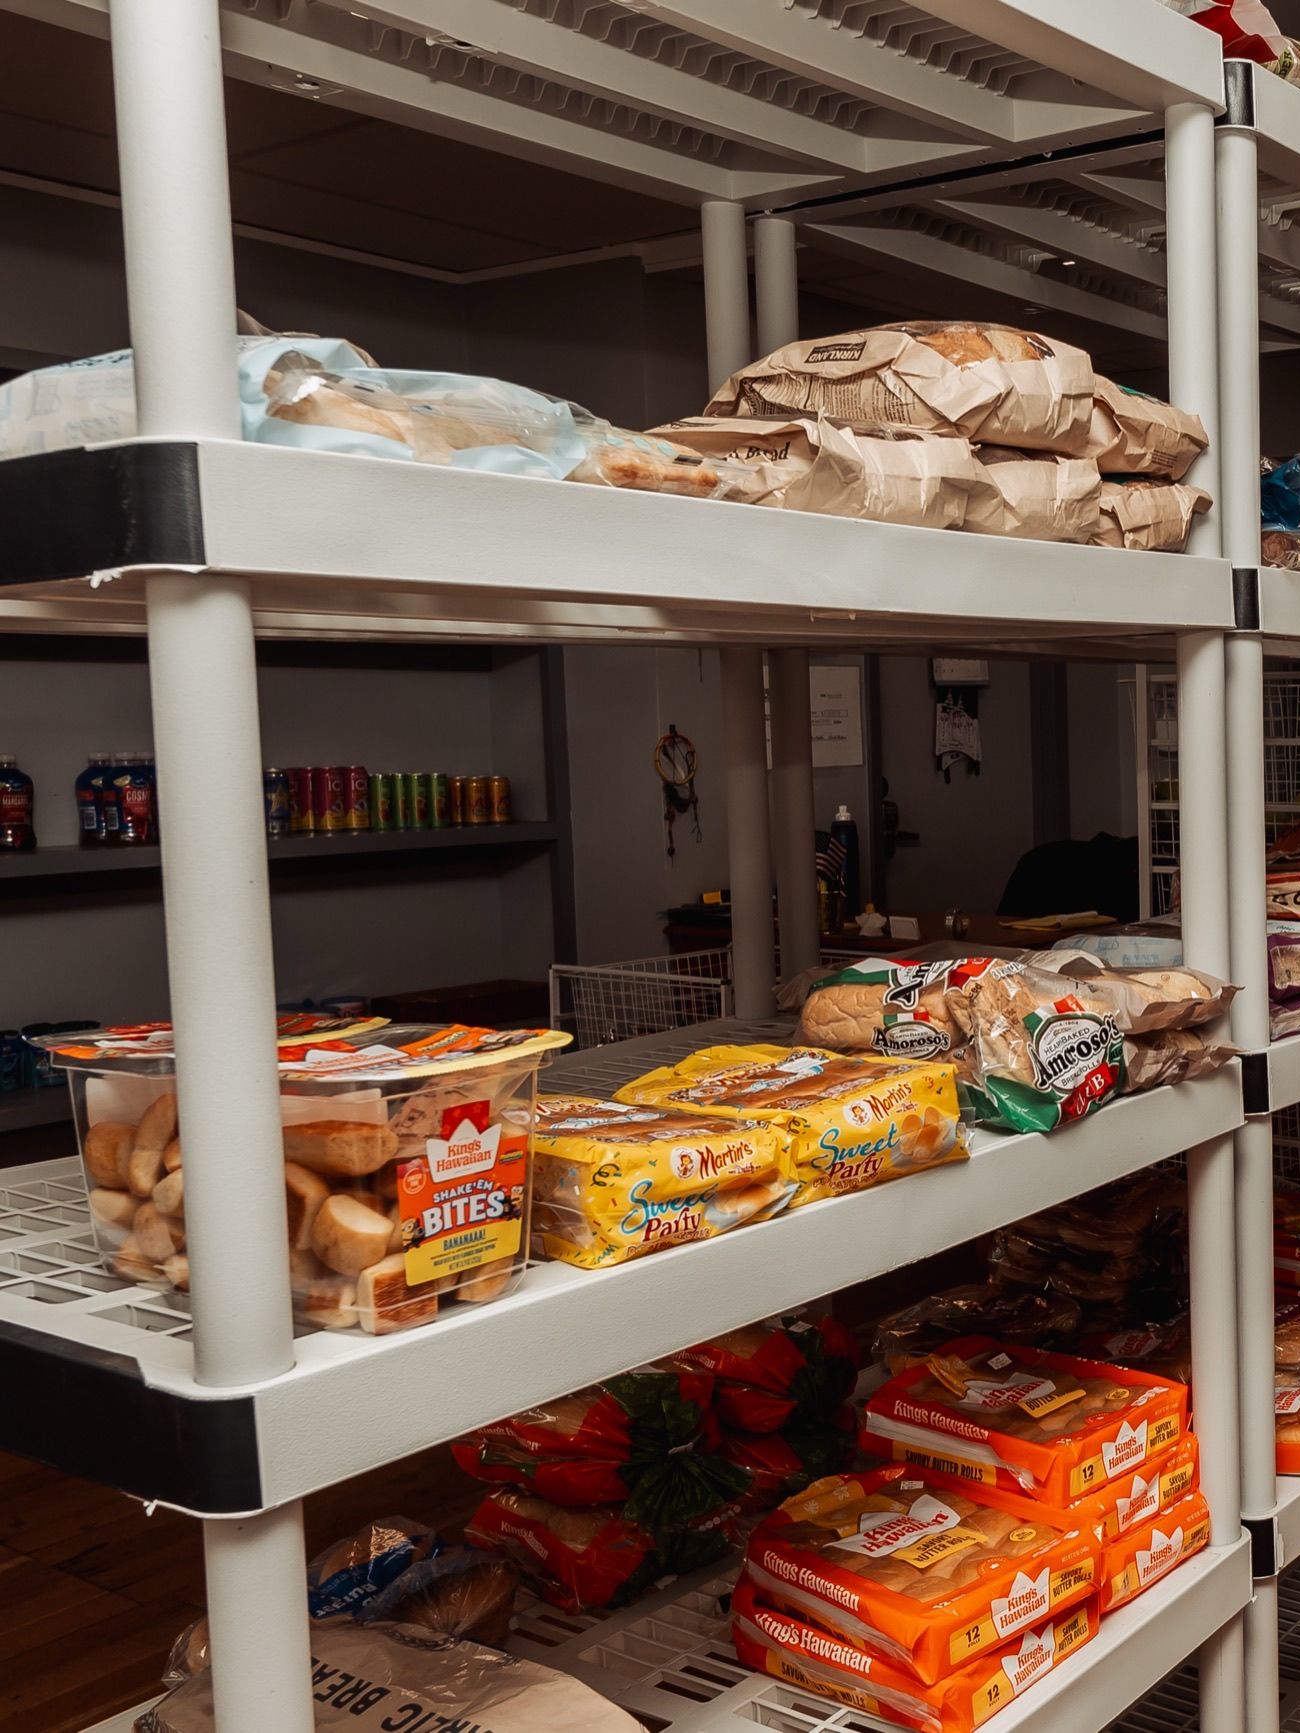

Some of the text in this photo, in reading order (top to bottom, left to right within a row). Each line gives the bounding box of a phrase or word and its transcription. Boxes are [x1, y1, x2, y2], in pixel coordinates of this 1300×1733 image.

[808, 349, 862, 363] KIRKLAND
[872, 1028, 951, 1051] Amoroso's
[869, 1082, 914, 1121] Martin's
[447, 1139, 483, 1158] King's
[811, 1121, 900, 1171] Sweet
[436, 1151, 493, 1173] Hawaiian
[698, 1142, 754, 1181] Martin's
[829, 1153, 884, 1181] Party
[422, 1190, 506, 1238] BITES
[620, 1179, 719, 1236] Sweet
[642, 1207, 703, 1243] Party
[893, 1399, 990, 1441] King's Hawaiian
[1155, 1420, 1172, 1434] SAVORY
[1114, 1435, 1138, 1455] King's
[1150, 1427, 1179, 1448] BUTTER ROLLS
[905, 1450, 984, 1481] SAVORY BUTTER ROLLS
[1108, 1444, 1145, 1471] Hawaiian
[1083, 1464, 1094, 1479] 12
[1168, 1471, 1187, 1487] SAVORY
[1149, 1543, 1173, 1564] King's
[763, 1550, 860, 1612] King's Hawaiian
[1053, 1570, 1092, 1598] BUTTER ROLLS
[1060, 1567, 1083, 1582] SAVORY
[1000, 1595, 1047, 1629] Hawaiian
[1007, 1588, 1038, 1611] King's
[965, 1625, 981, 1643] 12
[1058, 1622, 1088, 1653] BUTTER ROLLS
[1062, 1618, 1079, 1637] SAVORY
[754, 1612, 799, 1645] King's
[800, 1628, 872, 1674] Hawaiian
[1017, 1643, 1044, 1668] King's
[1014, 1650, 1051, 1686] Hawaiian
[986, 1684, 1000, 1702] 12
